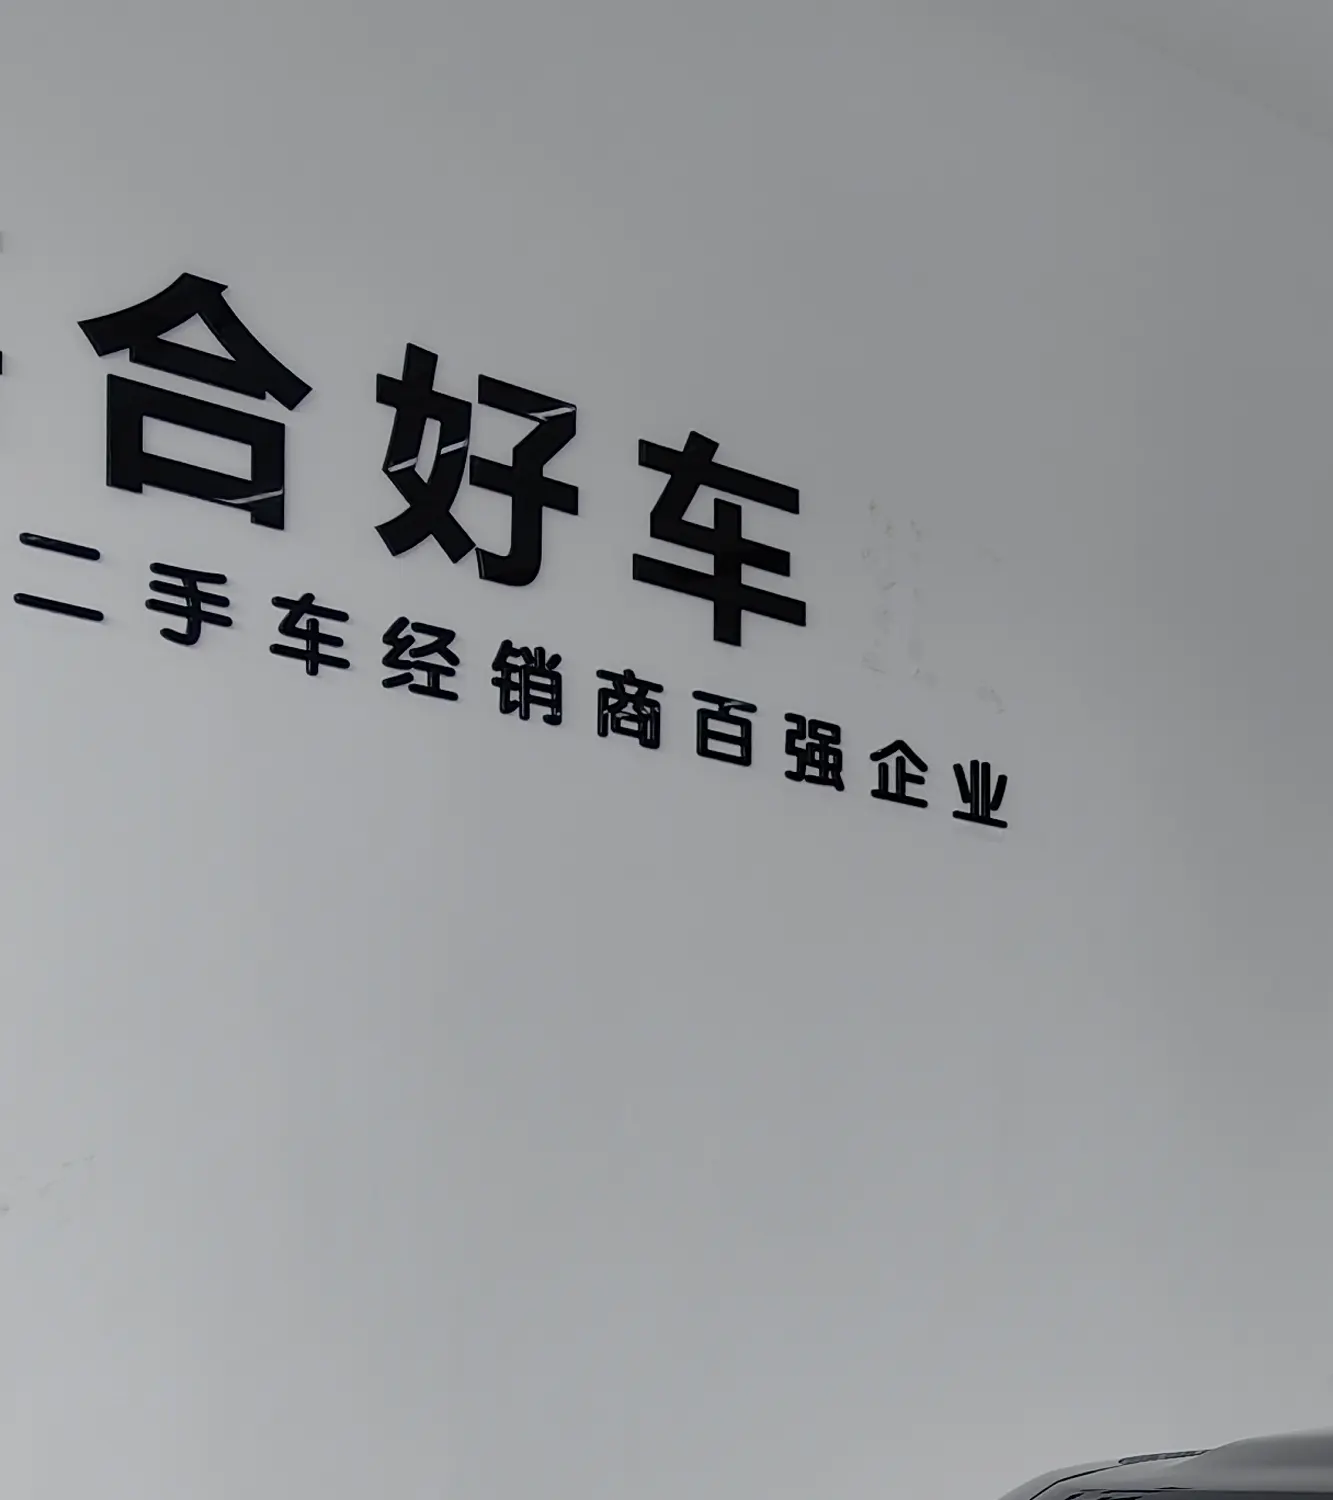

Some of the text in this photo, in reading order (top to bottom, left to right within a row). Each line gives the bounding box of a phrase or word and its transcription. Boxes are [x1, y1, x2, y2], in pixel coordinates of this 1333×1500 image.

[14, 532, 1008, 829] 二手车经销商百强企业
